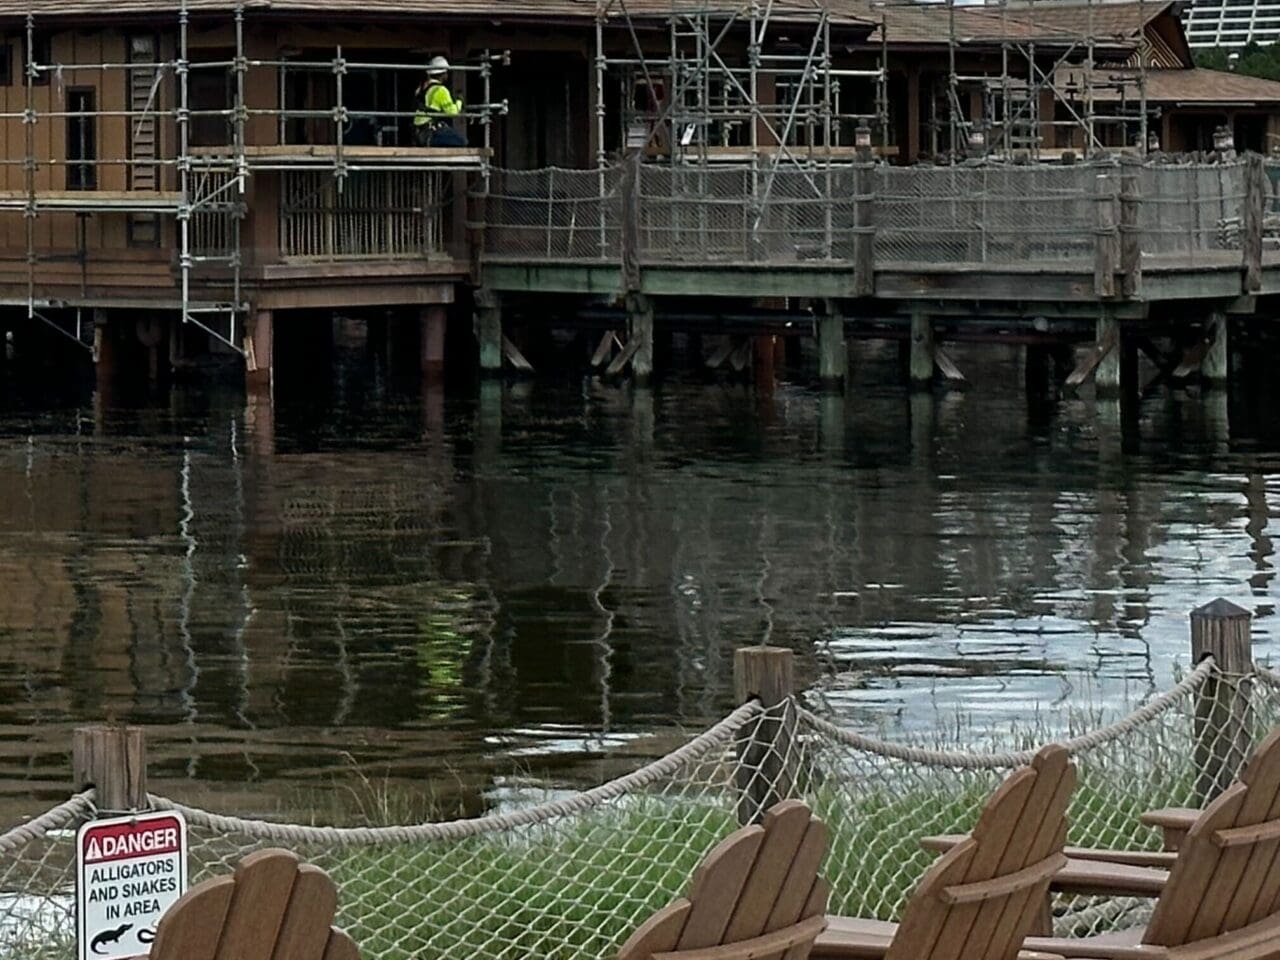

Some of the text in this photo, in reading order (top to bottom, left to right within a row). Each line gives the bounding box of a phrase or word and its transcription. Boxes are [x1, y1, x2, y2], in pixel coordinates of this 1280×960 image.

[102, 828, 177, 857] DANGER
[90, 859, 174, 884] ALLIGATORS
[88, 877, 177, 903] AND SNAKES
[106, 899, 161, 920] IN AREA
